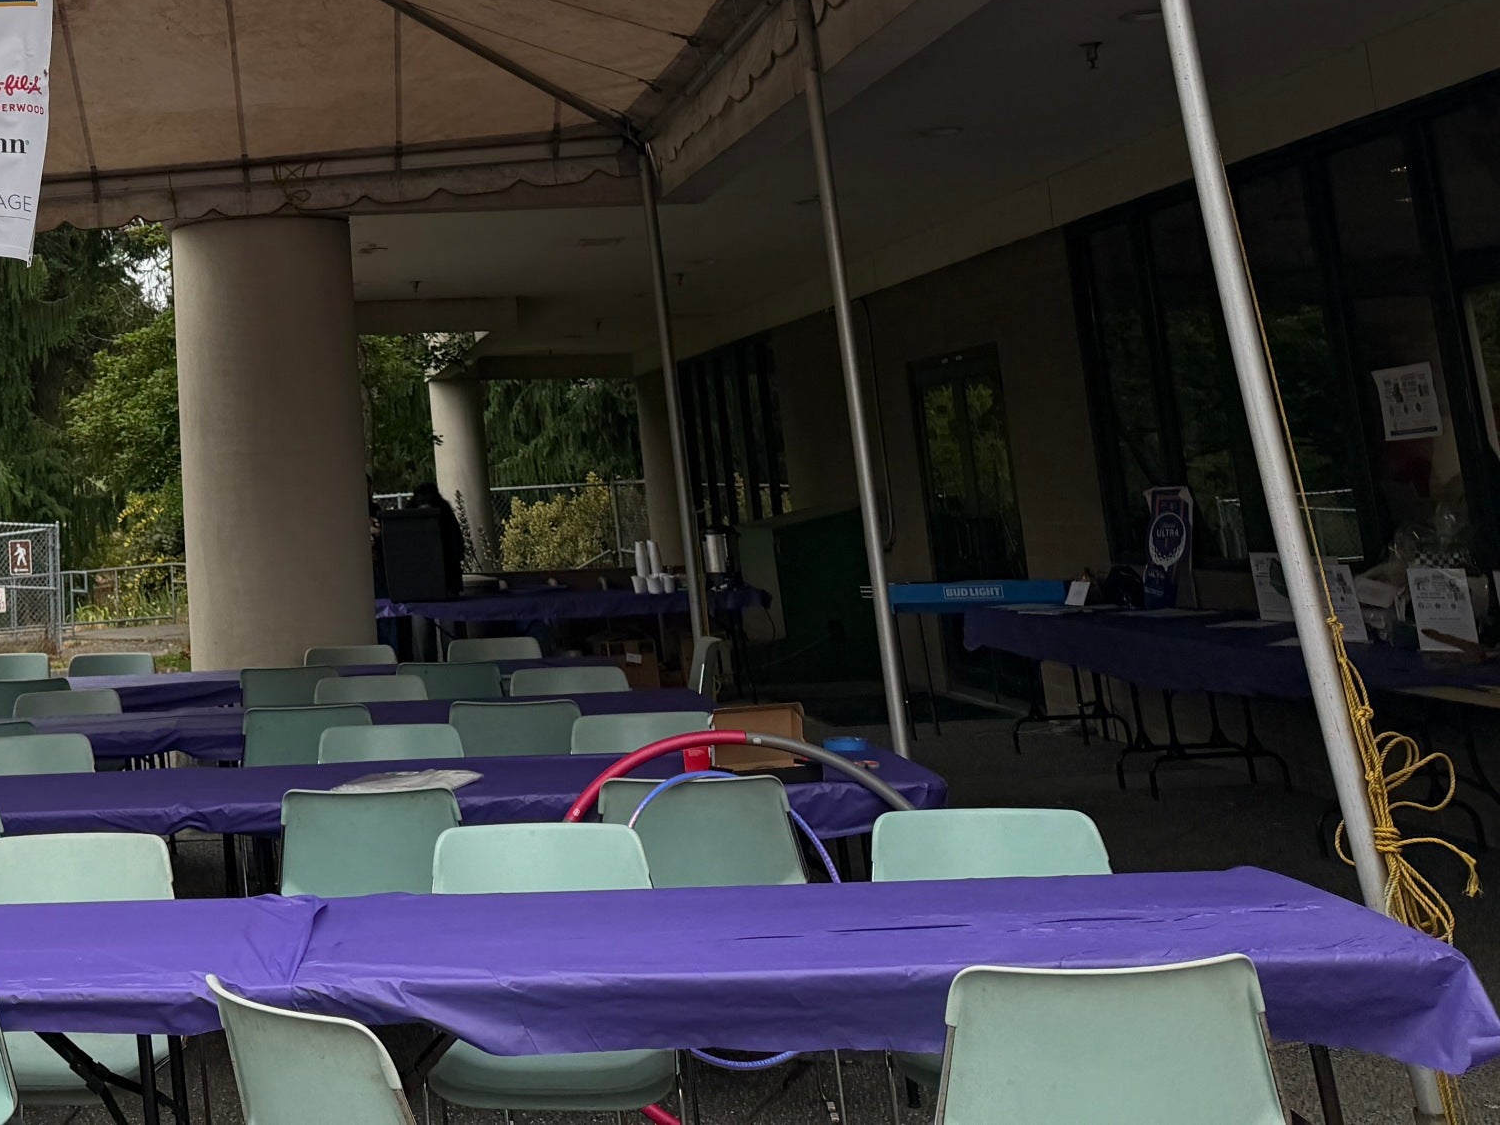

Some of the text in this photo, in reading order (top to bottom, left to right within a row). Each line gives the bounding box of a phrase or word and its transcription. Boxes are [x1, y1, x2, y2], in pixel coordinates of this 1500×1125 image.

[1156, 528, 1179, 538] ULTRA
[946, 587, 1000, 597] BUD LIGHT
